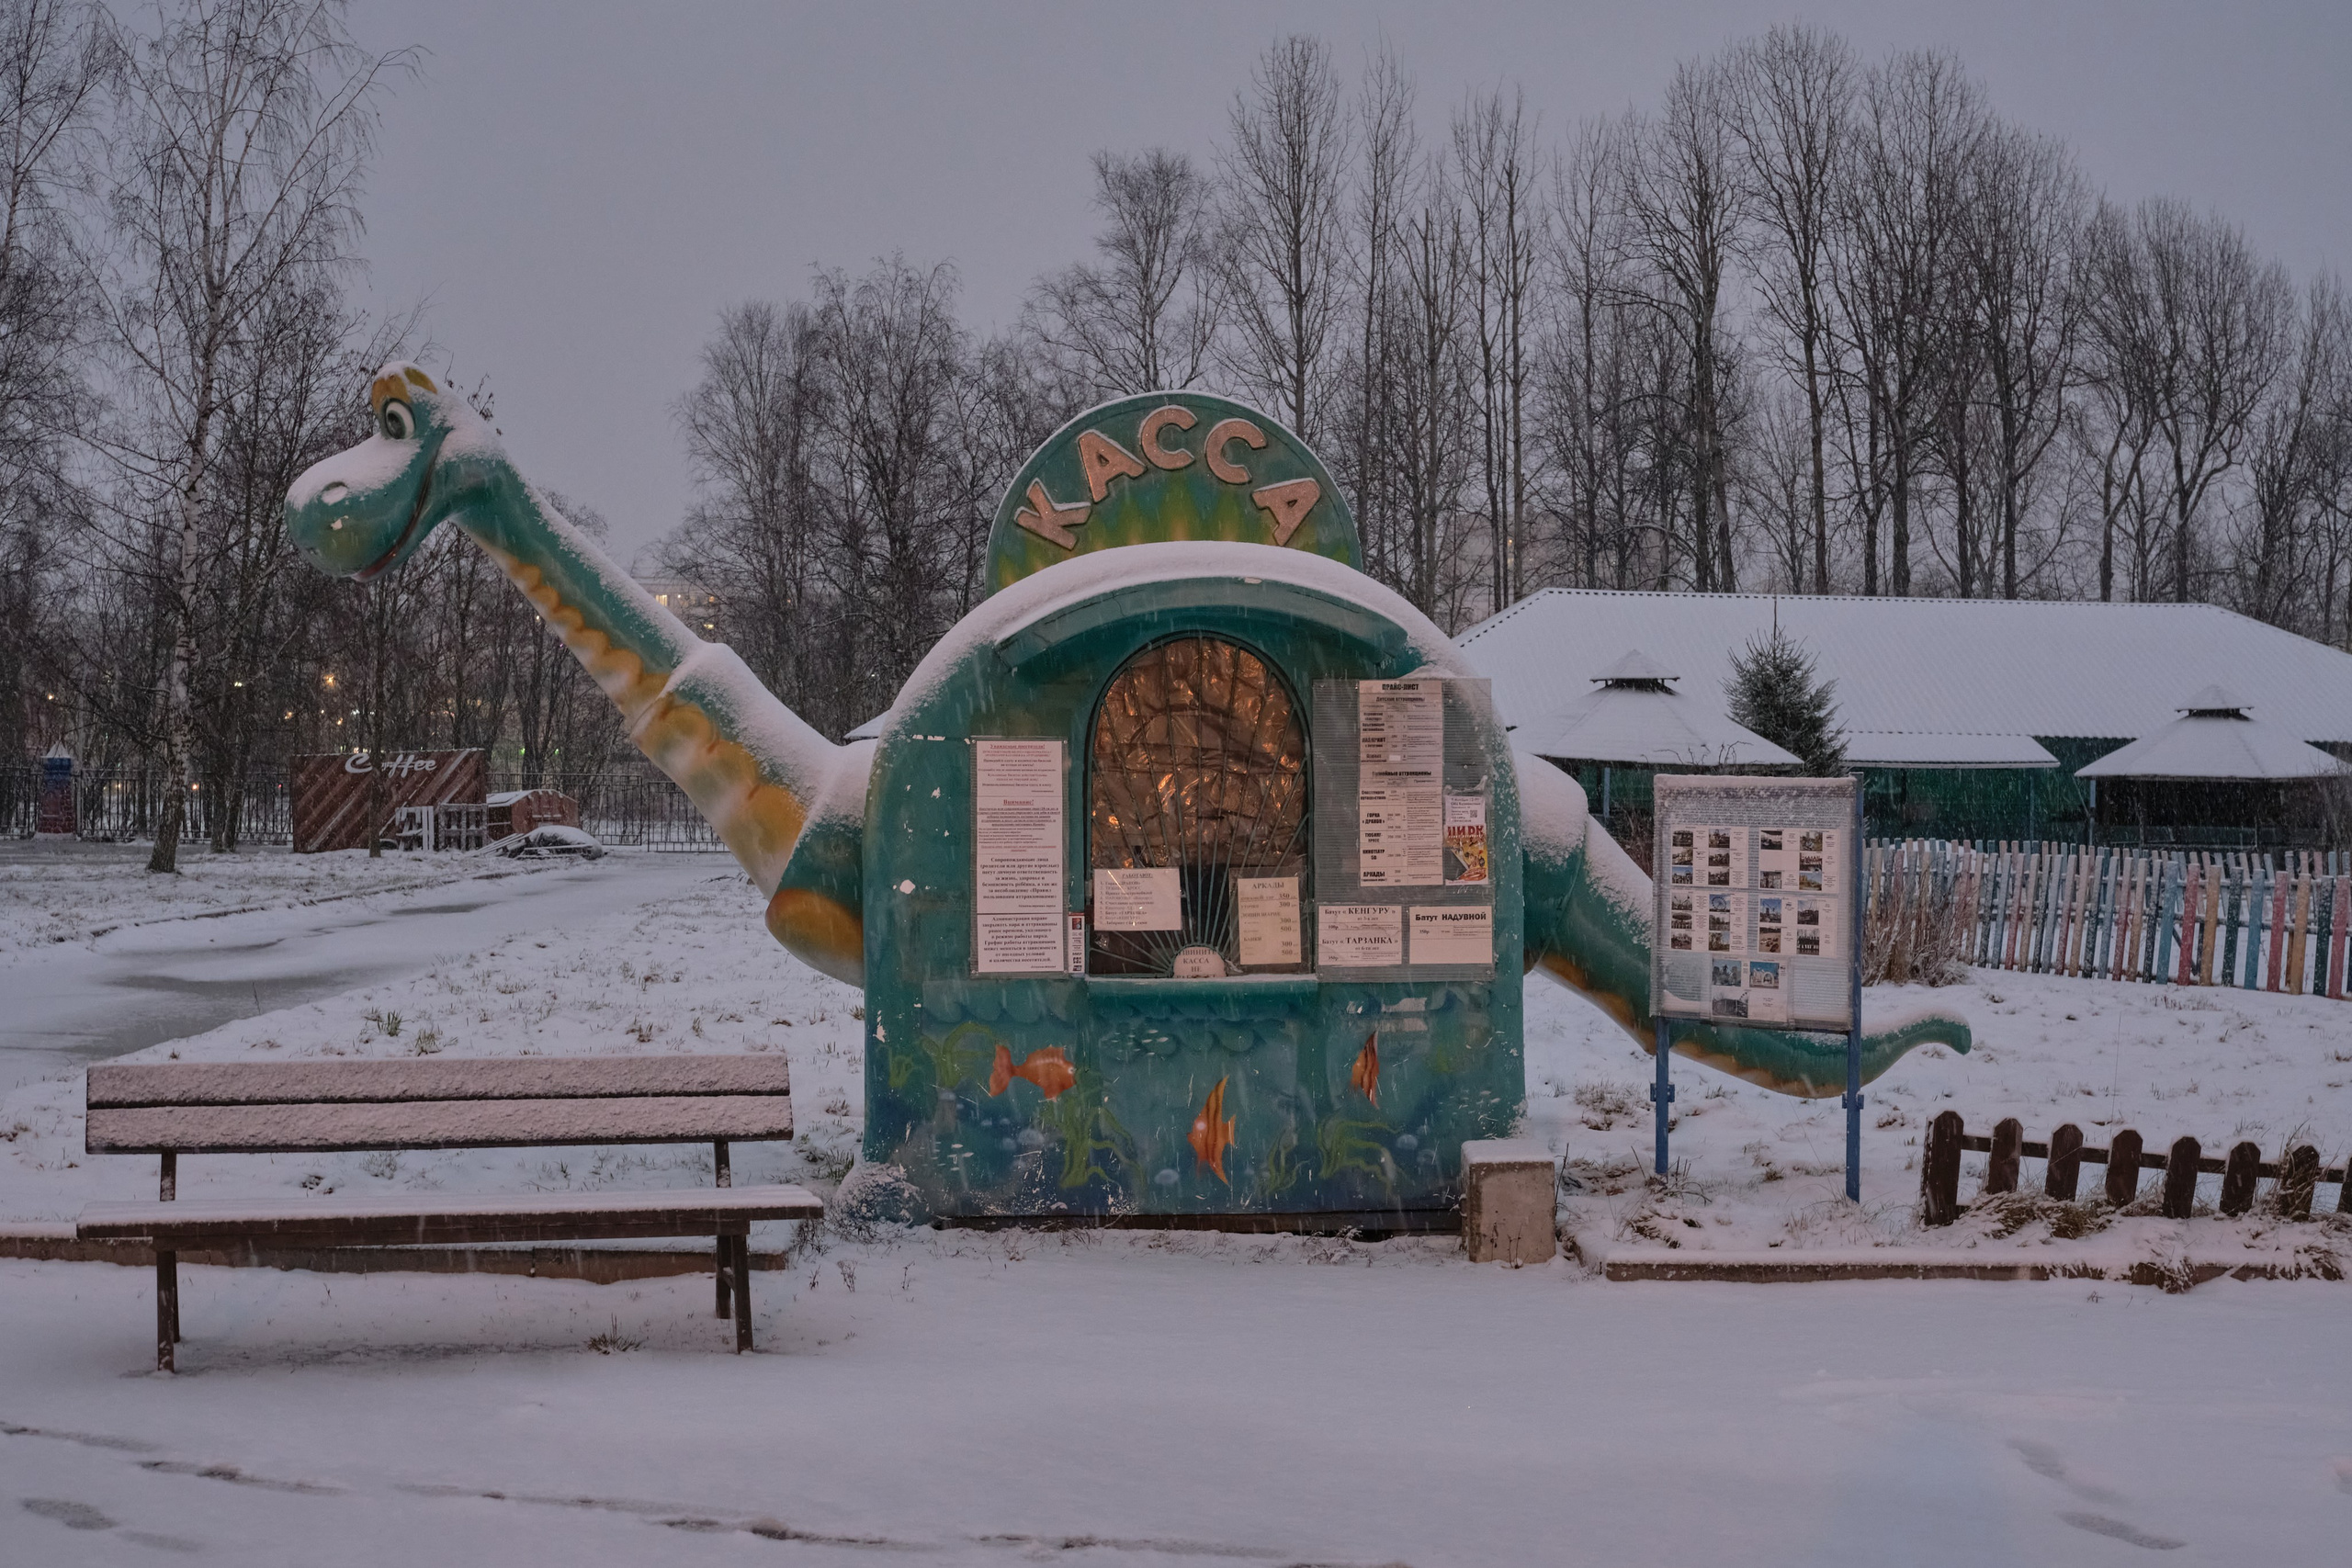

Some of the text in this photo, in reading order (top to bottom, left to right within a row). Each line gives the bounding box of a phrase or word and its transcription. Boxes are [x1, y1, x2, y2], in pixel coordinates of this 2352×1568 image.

[1014, 404, 1321, 550] КАССА
[345, 753, 437, 778] Cffee
[1442, 912, 1486, 921] НАДУВНОЙ
